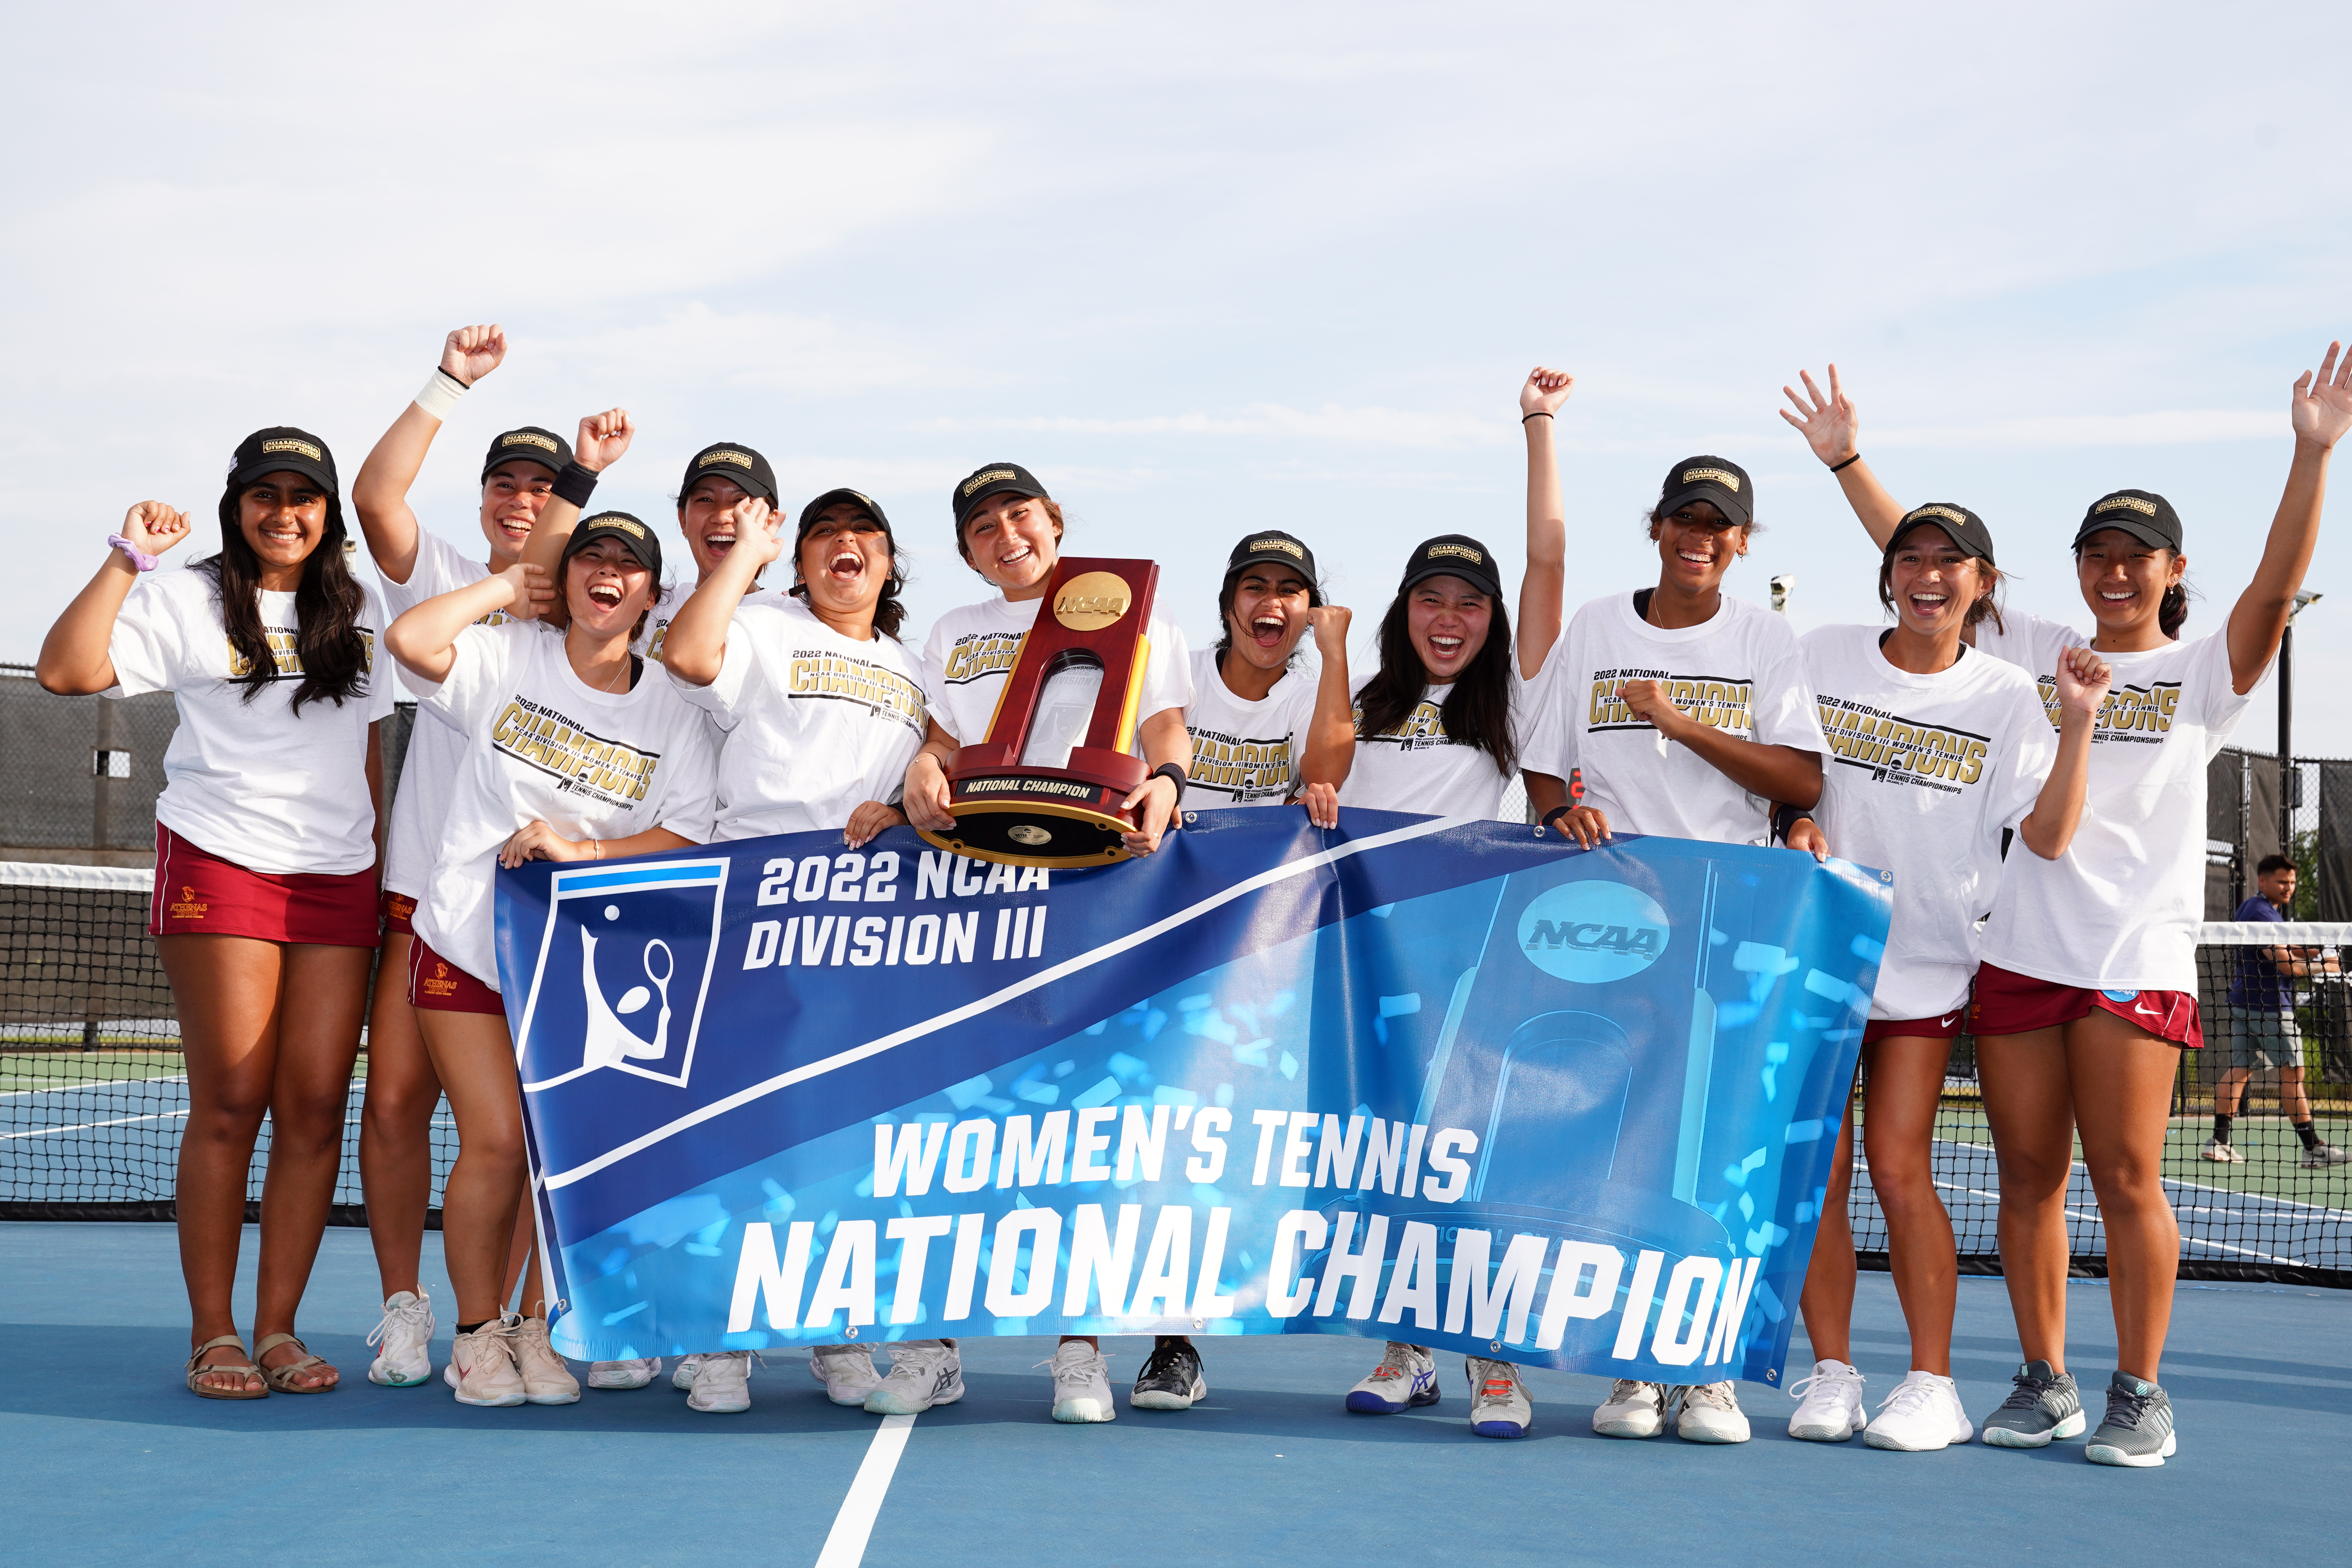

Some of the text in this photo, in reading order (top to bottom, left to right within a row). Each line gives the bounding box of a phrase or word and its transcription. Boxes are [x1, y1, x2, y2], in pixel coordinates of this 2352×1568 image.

[266, 441, 319, 458] CHAMPIONS
[701, 452, 751, 467] CHAMPIONS
[965, 471, 1013, 494] CHAMPIONS
[1686, 470, 1738, 488] CHAMPIONS
[1909, 506, 1964, 522] CHAMPIONS
[2098, 498, 2154, 514] CHAMPIONS
[1252, 541, 1302, 557] CHAMPIONS
[1430, 545, 1479, 562] CHAMPIONS
[1056, 597, 1126, 617] NCAA
[792, 650, 871, 668] 2022 NATIONAL
[834, 672, 867, 683] DIVISION
[1050, 675, 1092, 686] DIVISION
[1594, 669, 1670, 680] 2022 NATIONAL
[1675, 698, 1714, 707] WOMEN'S
[1718, 701, 1745, 709] TENNIS
[1817, 695, 1892, 720] 2022 NATIONAL
[515, 694, 585, 734] 2022 NATIONAL
[882, 710, 900, 721] TENNIS
[1198, 728, 1242, 746] NATIONAL
[1819, 706, 1987, 785] HAMPIONS
[1839, 729, 1877, 745] DIVISION
[1879, 737, 1890, 746] III
[1892, 740, 1932, 754] WOMEN'S
[1934, 750, 1964, 762] TENNIS
[2110, 735, 2164, 744] CHAMPIONSHIPS
[493, 702, 657, 801] CHAMPIONS
[514, 726, 533, 739] NCAA
[535, 735, 569, 753] DIVISION
[582, 755, 617, 772] WOMEN'S
[619, 769, 643, 781] TENNIS
[1200, 756, 1232, 767] DIVISION
[966, 780, 1090, 799] NATIONAL CHAMPION
[1888, 773, 1962, 794] TENNIS CHAMPIONSHIPS
[572, 785, 593, 796] TENNIS
[592, 792, 634, 811] CHAMPIONSHIPS
[757, 851, 1049, 907] 2022 NCAA
[170, 902, 207, 911] ATHENAS
[743, 905, 1047, 970] DIVISION III
[1525, 919, 1661, 961] NCAA
[423, 977, 457, 990] ATHENAS
[873, 1106, 1479, 1204] WOMEN'S TENNIS
[727, 1203, 1761, 1367] NATIONAL CHAMPION
